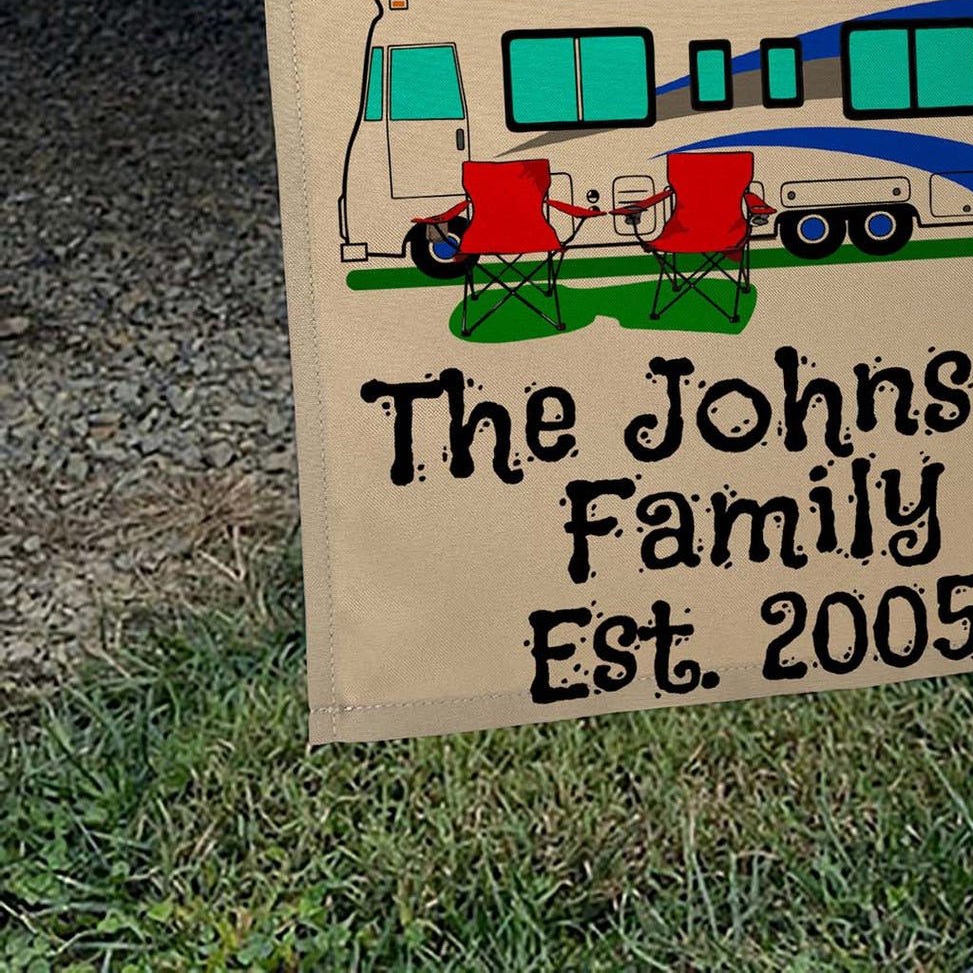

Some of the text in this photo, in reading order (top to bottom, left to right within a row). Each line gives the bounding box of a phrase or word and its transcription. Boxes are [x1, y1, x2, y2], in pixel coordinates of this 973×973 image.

[361, 368, 577, 487] The
[562, 457, 945, 585] Family
[527, 599, 721, 705] Est.
